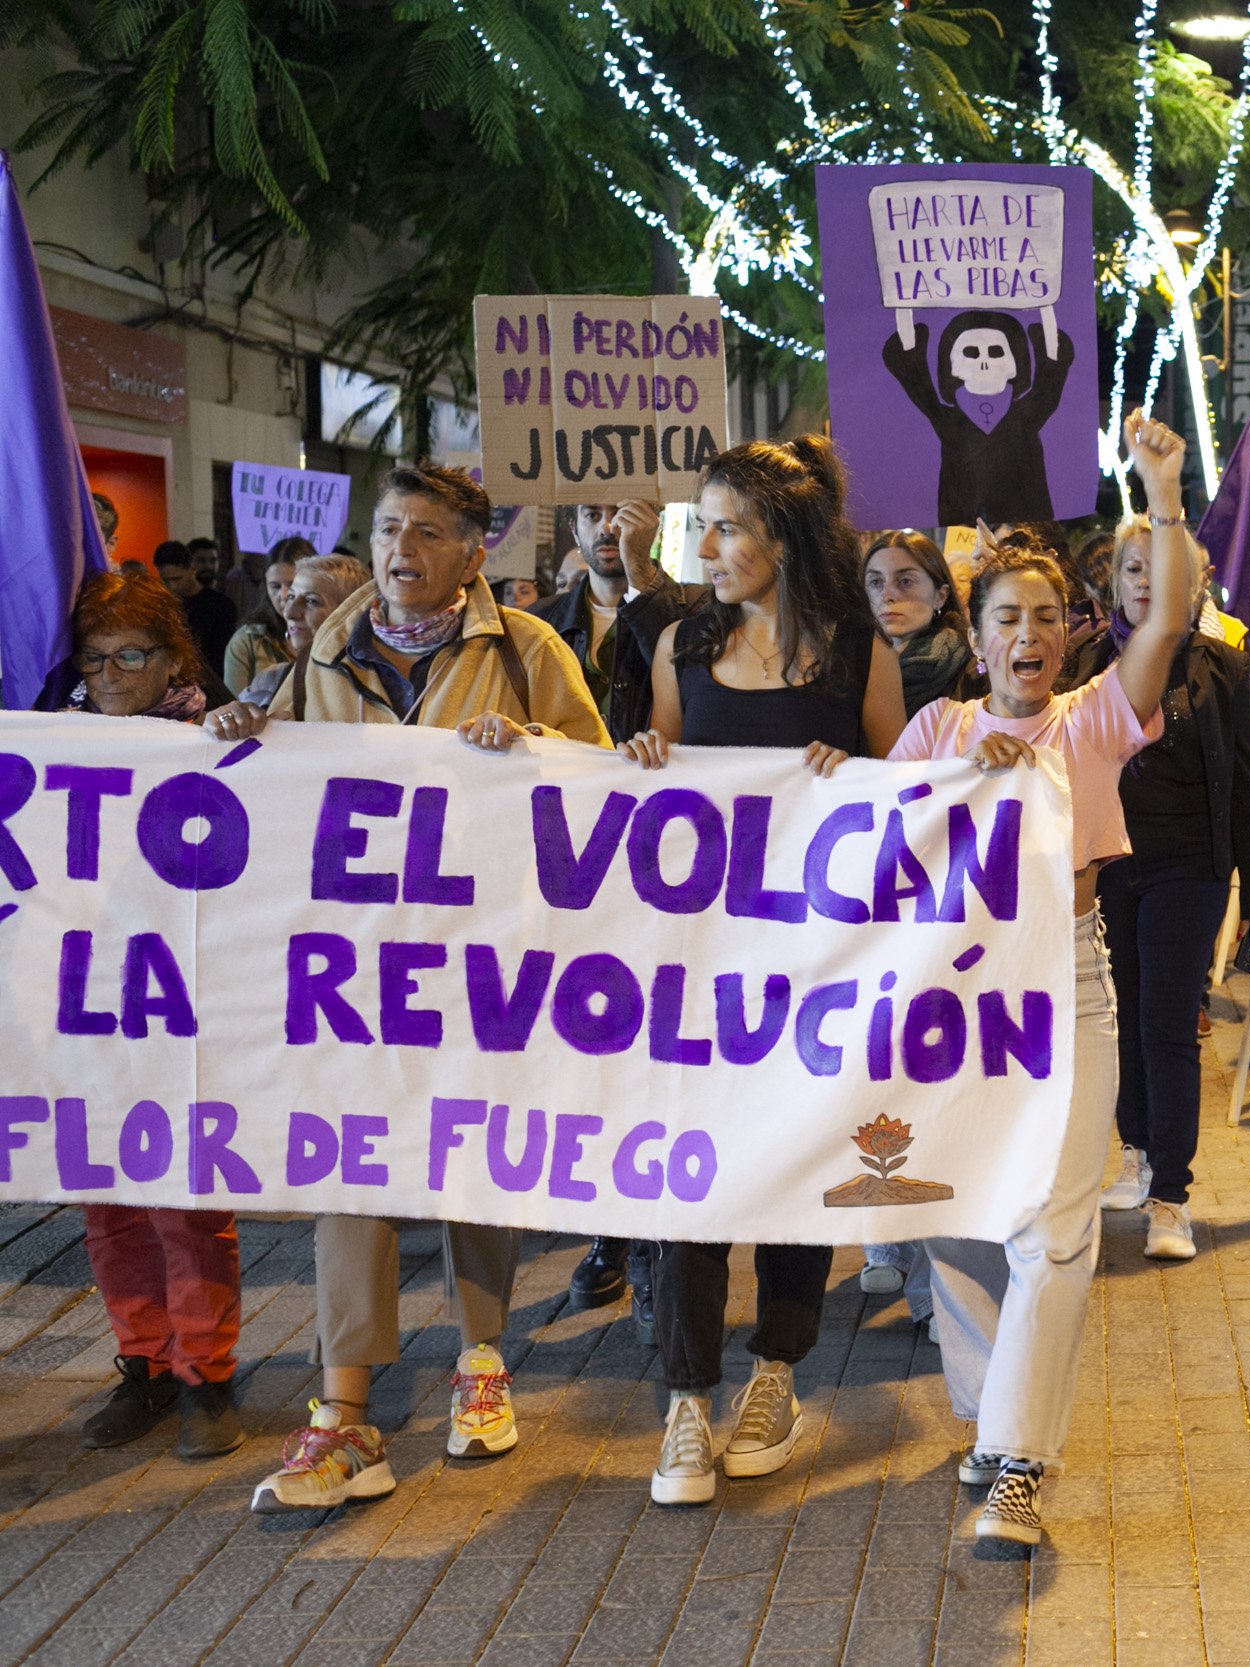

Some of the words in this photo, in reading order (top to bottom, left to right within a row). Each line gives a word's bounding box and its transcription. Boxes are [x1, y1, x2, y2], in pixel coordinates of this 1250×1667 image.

[886, 194, 988, 231] HARTA
[1003, 194, 1041, 228] DE
[898, 236, 1008, 263] LLEVARME
[1018, 237, 1039, 263] A
[894, 267, 951, 301] LAS
[967, 266, 1048, 299] PIBAS
[495, 313, 551, 356] NI
[573, 311, 719, 360] PERDÓN
[502, 366, 551, 406] NI
[564, 369, 700, 414] OLVIDO
[510, 424, 720, 483] JUSTICIA
[237, 471, 265, 496] TU
[276, 475, 341, 508] COLEGA
[311, 776, 475, 907] EL
[531, 782, 1023, 925] VOLCÁN
[58, 930, 198, 1039] LA
[0, 1096, 263, 1195] FLOR
[286, 1112, 389, 1187] DE
[428, 1097, 718, 1203] FUEGO
